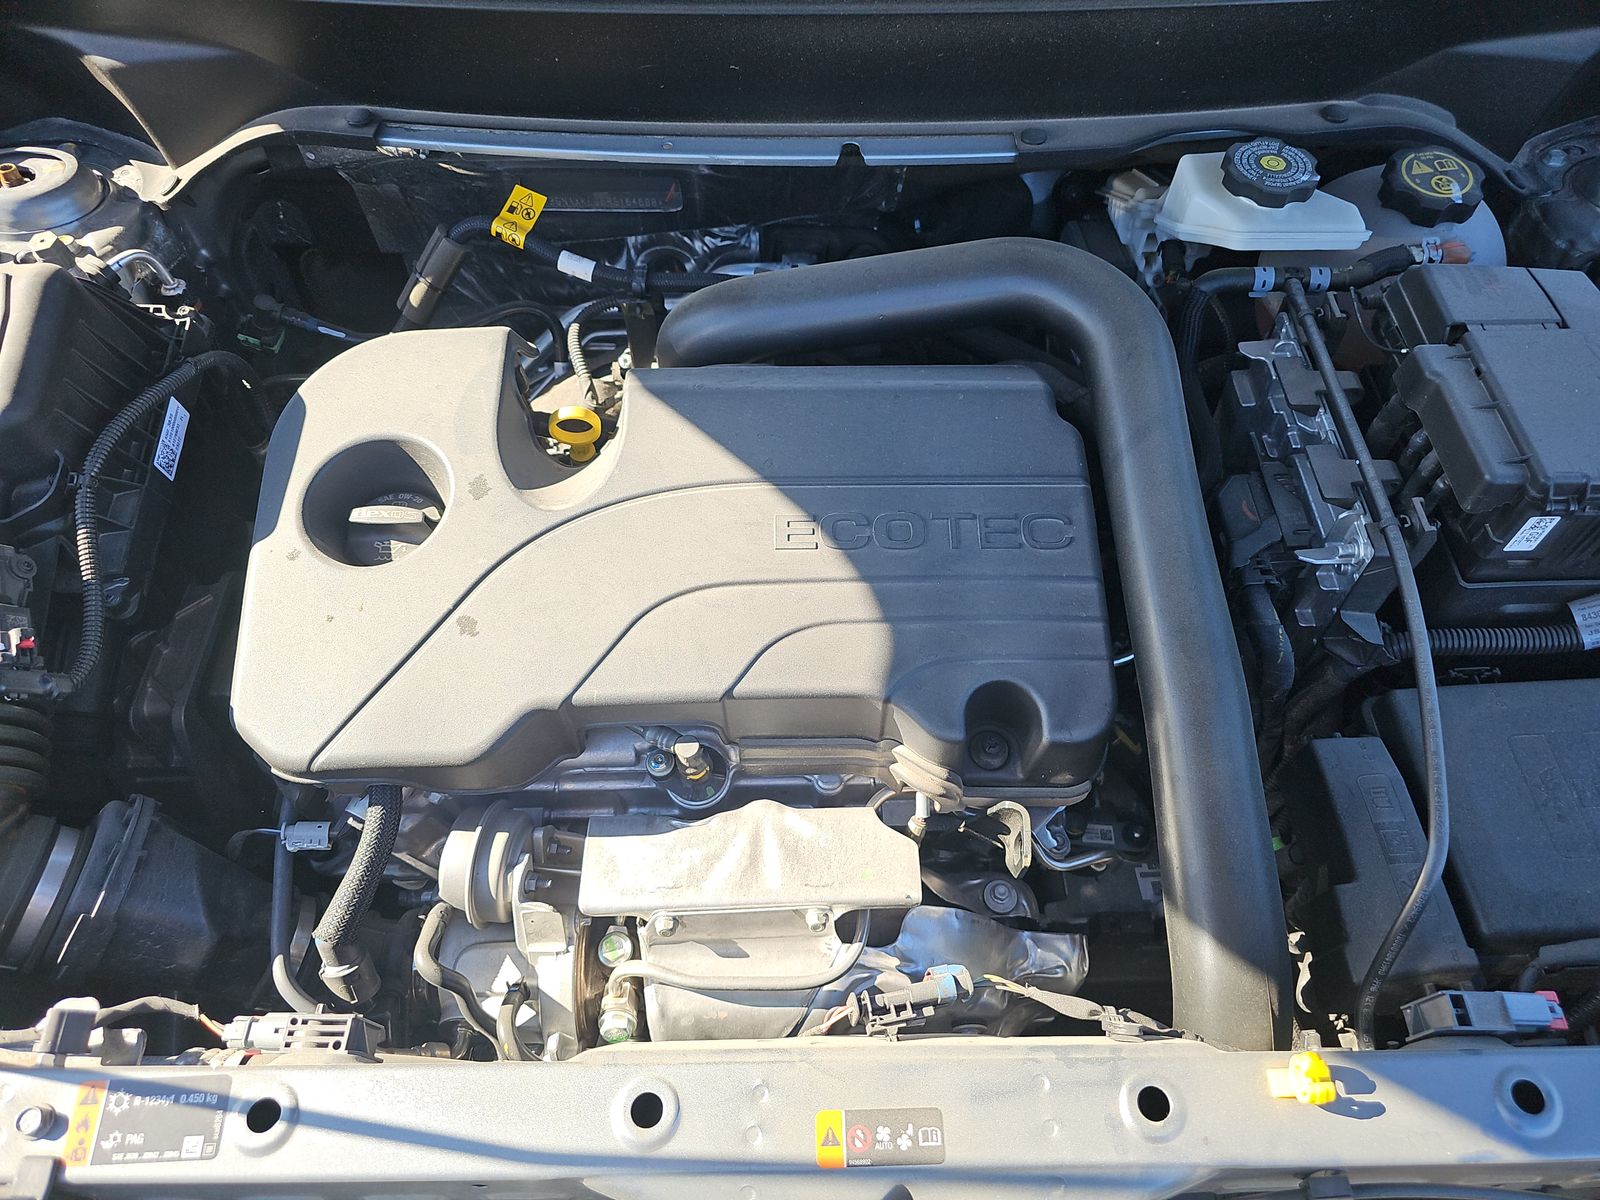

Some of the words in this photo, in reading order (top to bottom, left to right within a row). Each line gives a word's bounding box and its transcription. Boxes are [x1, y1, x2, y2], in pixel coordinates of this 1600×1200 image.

[398, 493, 424, 504] 0W-20
[774, 511, 1076, 551] ECOTEC
[179, 1093, 205, 1104] 0.450
[206, 1093, 218, 1104] kg
[125, 1132, 145, 1145] PAG
[874, 1141, 893, 1150] AUTO
